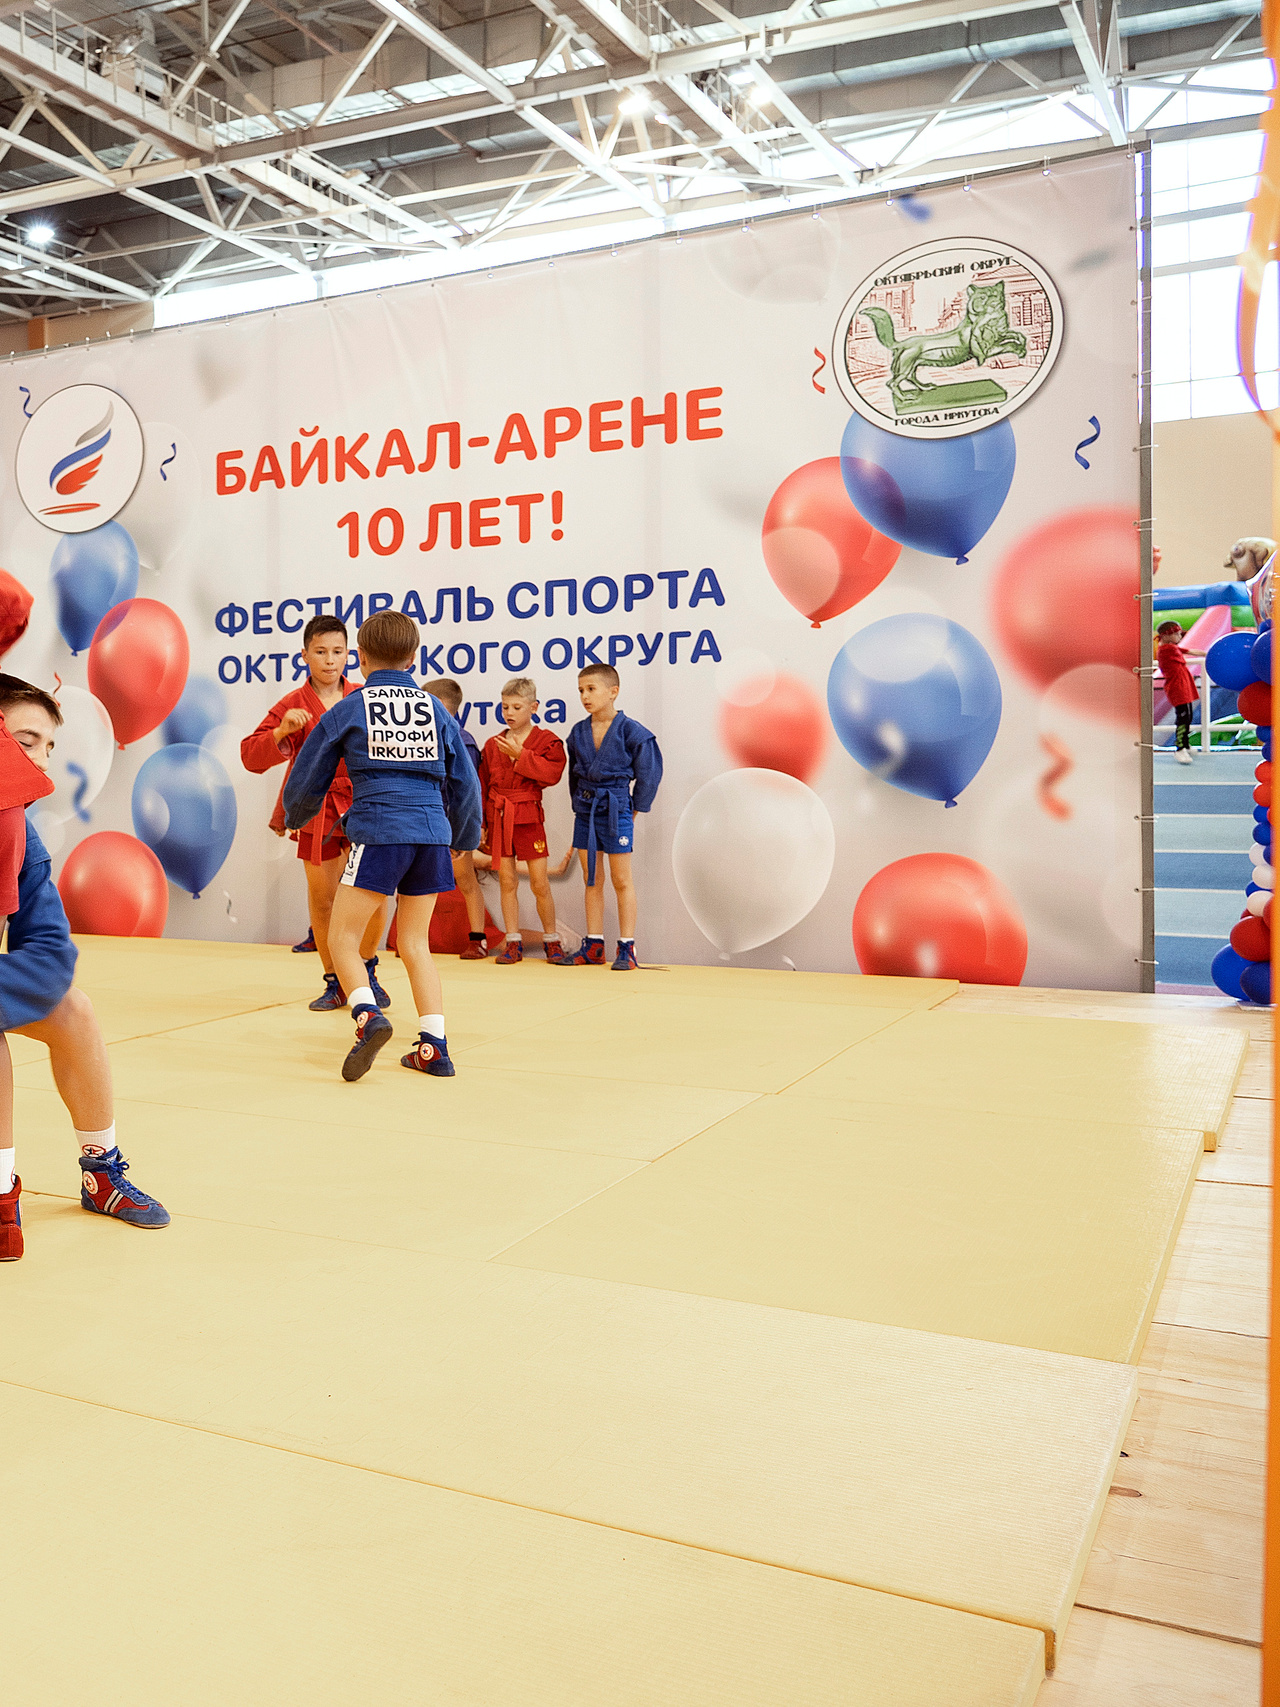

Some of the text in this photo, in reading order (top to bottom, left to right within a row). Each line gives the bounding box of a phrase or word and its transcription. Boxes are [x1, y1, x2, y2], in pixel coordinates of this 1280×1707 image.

[873, 256, 1013, 287] ОКТЯБРЬСКИЙ ОКРУГ
[894, 413, 939, 426] ГОРОДА
[216, 386, 723, 496] БАЙКАЛ-АРЕНЕ
[337, 490, 564, 558] 10 ЛЕТ!
[507, 567, 726, 620] СПОРТА
[542, 629, 723, 670] ОКРУГА
[368, 688, 426, 699] SAMBO
[368, 701, 432, 726] RUS
[372, 729, 434, 742] ПРОФИ
[371, 746, 435, 759] IRKUTSK
